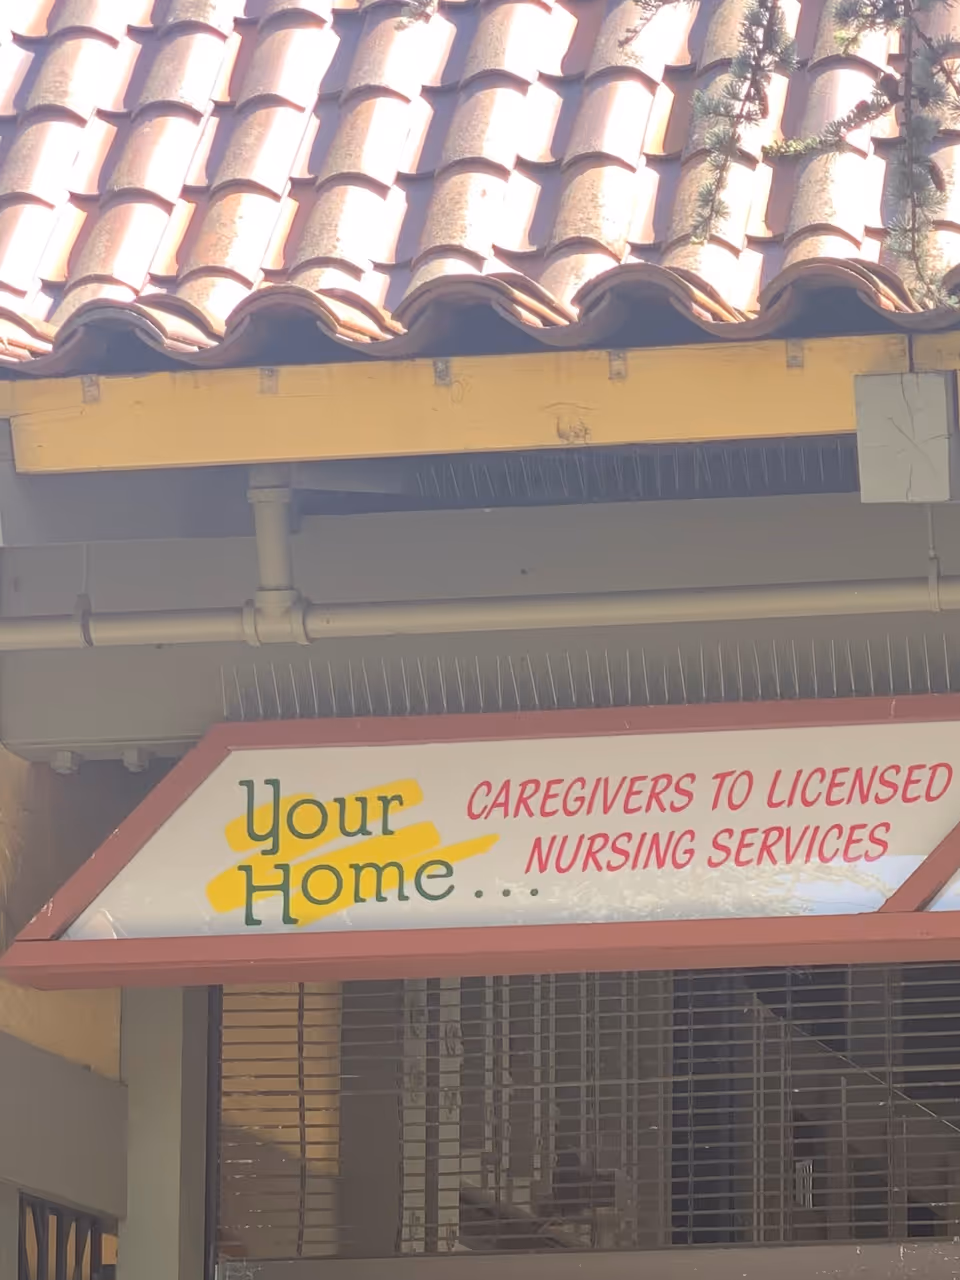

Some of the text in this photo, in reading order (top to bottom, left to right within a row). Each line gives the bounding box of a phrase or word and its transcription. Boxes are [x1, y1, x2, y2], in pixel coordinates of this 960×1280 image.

[239, 778, 404, 856] Your
[466, 762, 953, 820] CAREGIVERS TO LICENSED
[525, 821, 892, 874] NURSING SERVICES
